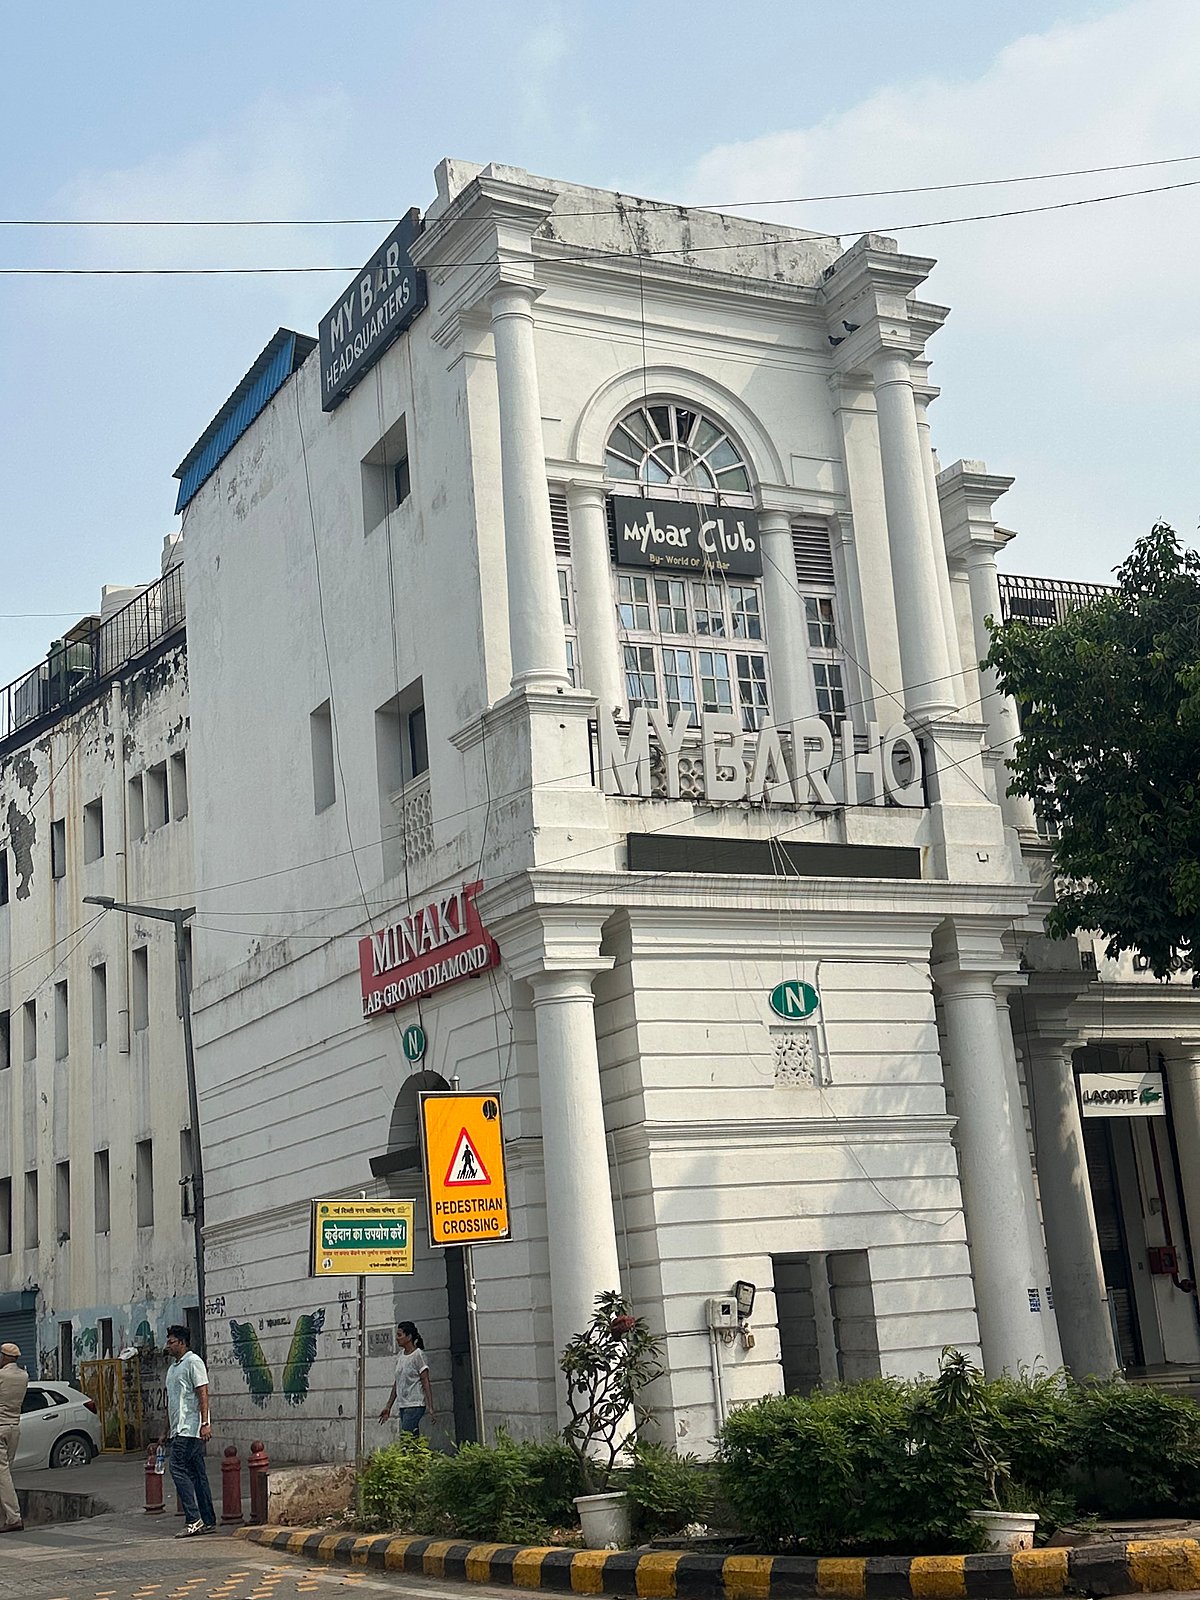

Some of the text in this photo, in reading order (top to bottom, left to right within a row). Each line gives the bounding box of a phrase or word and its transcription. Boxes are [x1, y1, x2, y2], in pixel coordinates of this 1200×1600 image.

[330, 241, 401, 354] MY BAR
[325, 277, 411, 393] HEADQUARTERS
[623, 511, 756, 554] Mybar Club
[665, 555, 689, 566] World
[370, 890, 468, 977] MINAKI
[361, 943, 487, 1016] LAB GROWN DIAMOND
[785, 986, 806, 1013] N
[408, 1030, 419, 1056] N
[1083, 1089, 1138, 1105] LACOSTE
[435, 1197, 503, 1216] PEDESTRIAN
[352, 1228, 363, 1241] का
[364, 1223, 390, 1241] उपयोग
[443, 1217, 499, 1235] CROSSING
